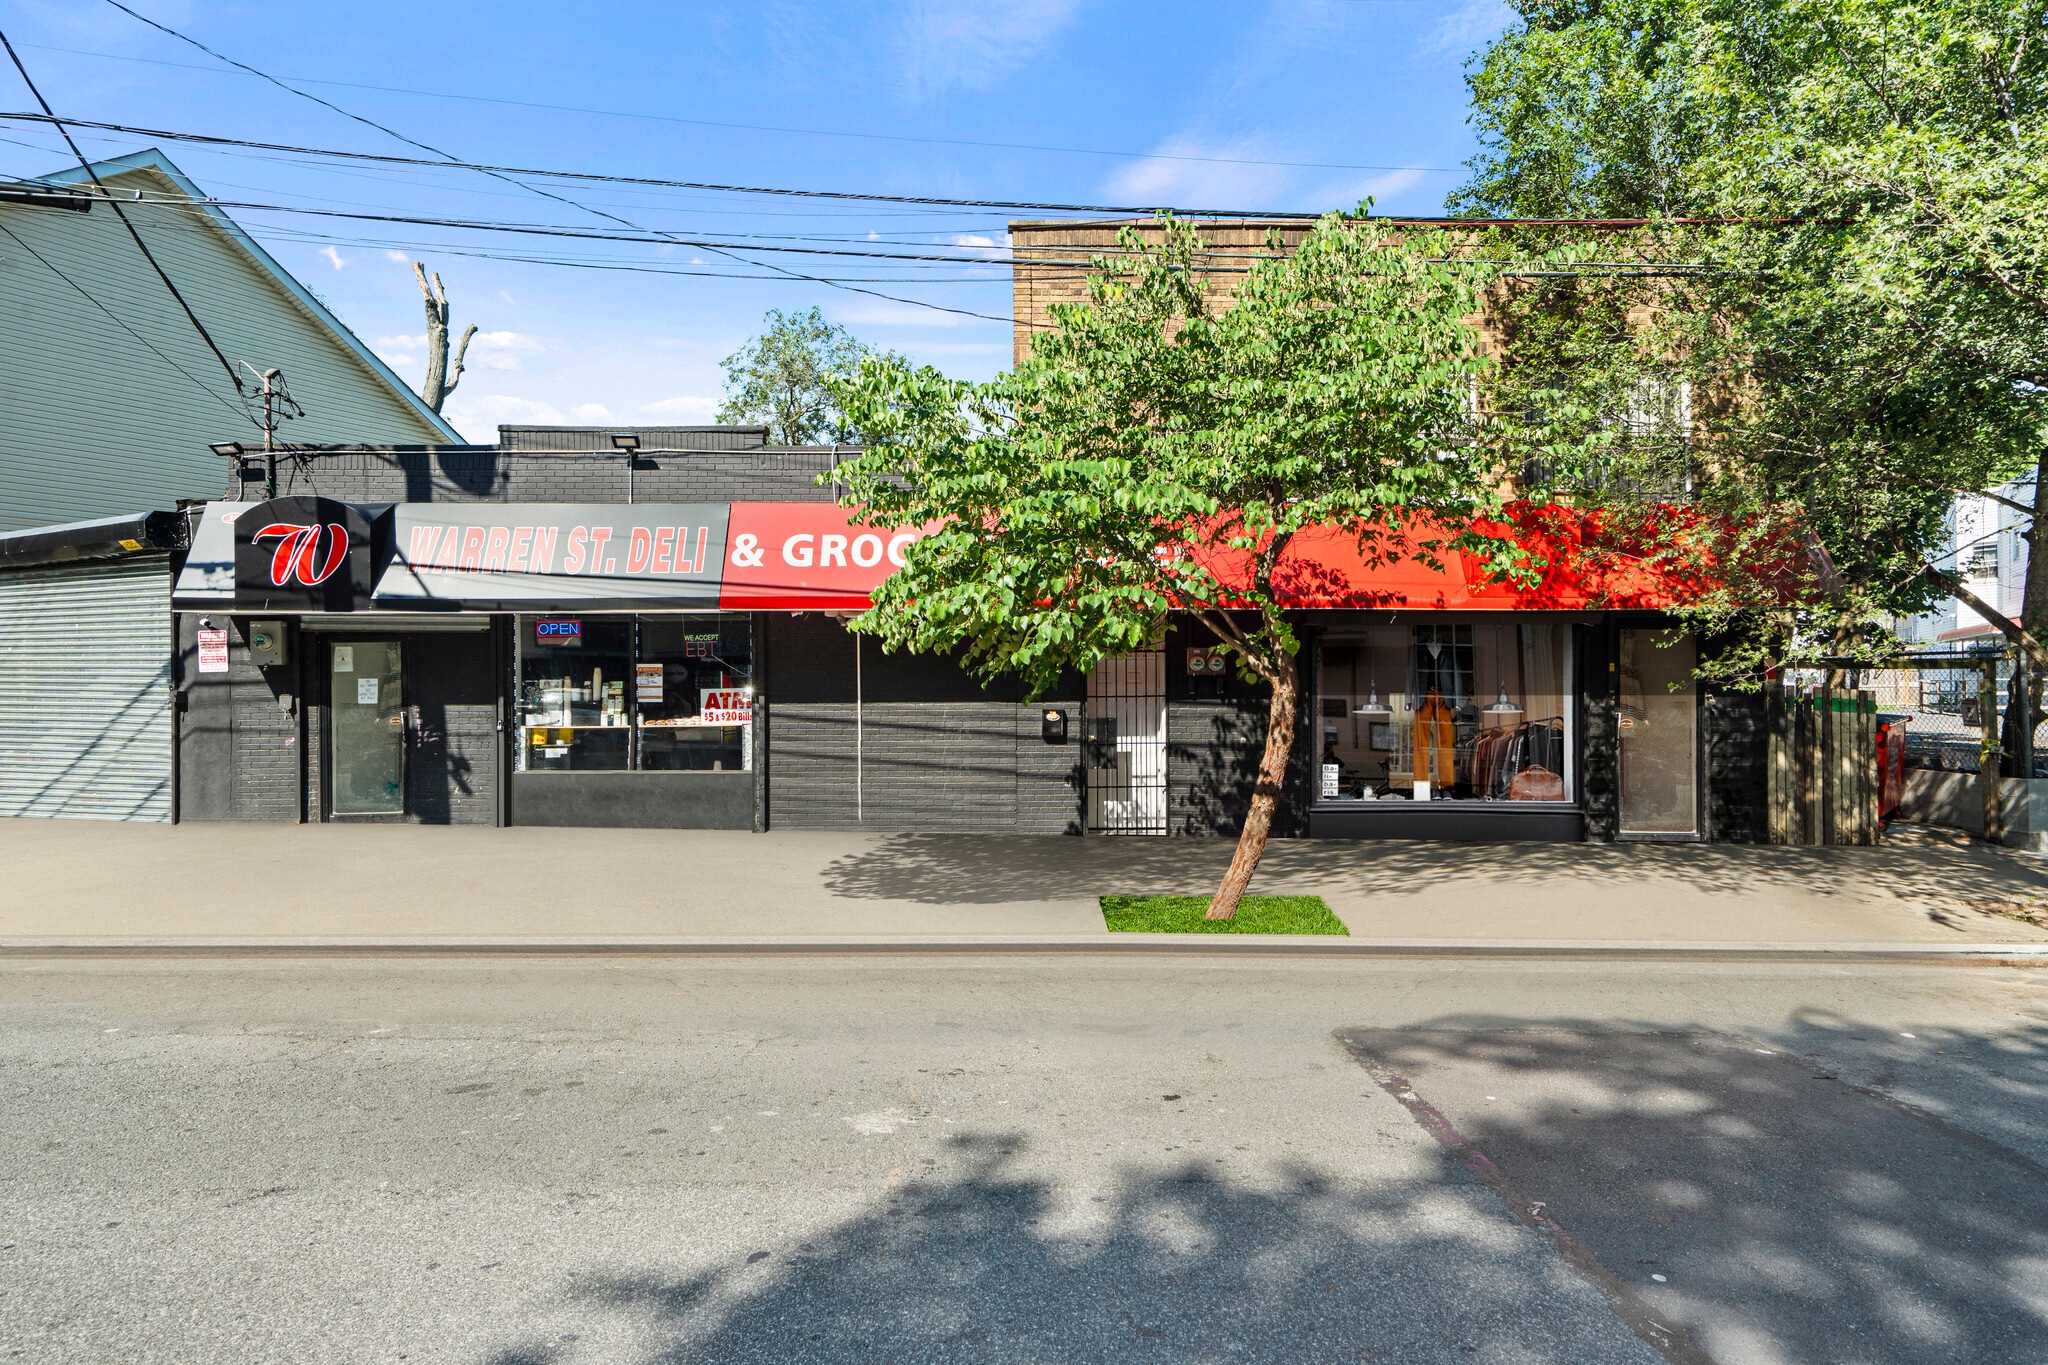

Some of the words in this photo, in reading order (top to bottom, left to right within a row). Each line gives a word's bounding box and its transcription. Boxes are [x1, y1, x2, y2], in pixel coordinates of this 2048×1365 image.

[251, 523, 349, 586] W
[407, 526, 559, 575] WARREN
[564, 526, 616, 575] ST.
[625, 526, 709, 574] DELI
[730, 533, 765, 567] &
[781, 533, 917, 568] GROC
[538, 623, 579, 635] OPEN
[695, 633, 719, 641] ACCEPT
[685, 641, 717, 657] EBT
[704, 691, 752, 710] ATM
[704, 711, 715, 722] $5
[721, 711, 737, 721] $20
